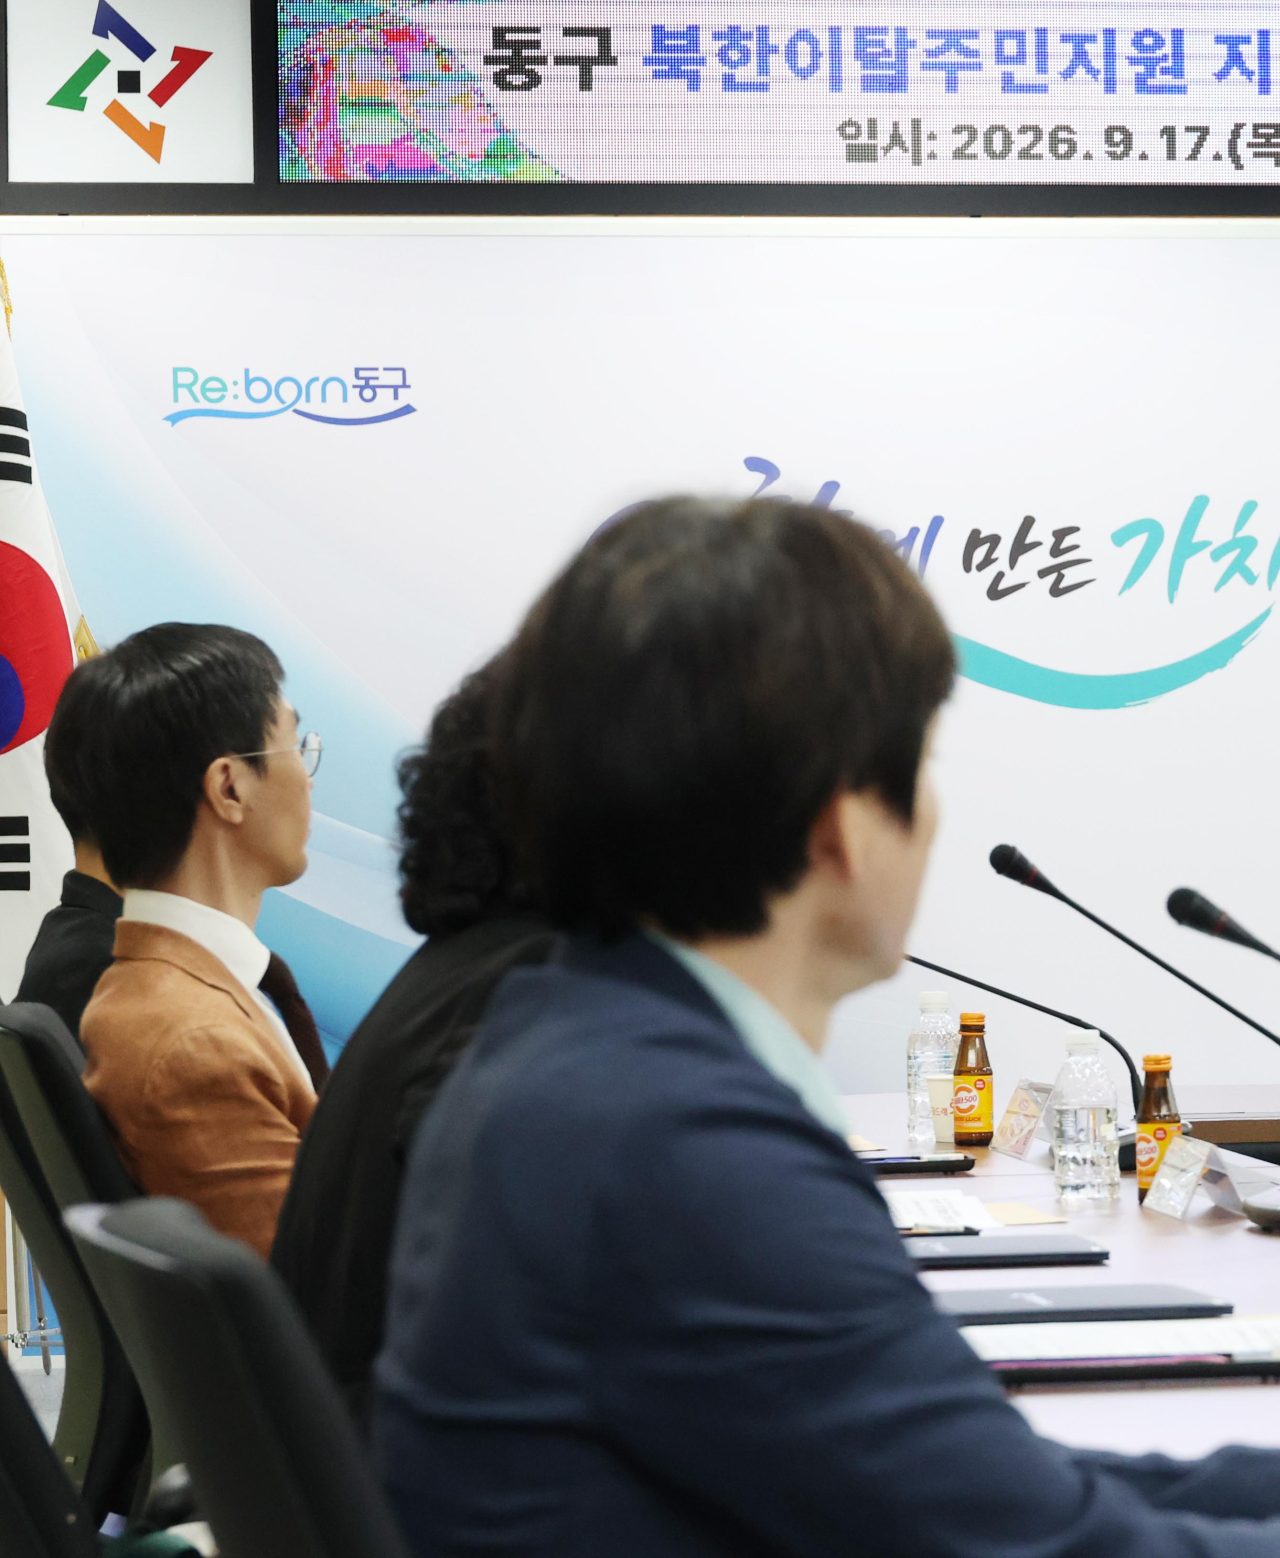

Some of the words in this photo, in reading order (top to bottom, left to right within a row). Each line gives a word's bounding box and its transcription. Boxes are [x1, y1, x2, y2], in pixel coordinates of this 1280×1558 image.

[482, 24, 619, 93] 동구
[641, 24, 1189, 95] 북한이탈주민지원
[836, 117, 938, 167] 일시:
[961, 514, 1098, 602] 만든
